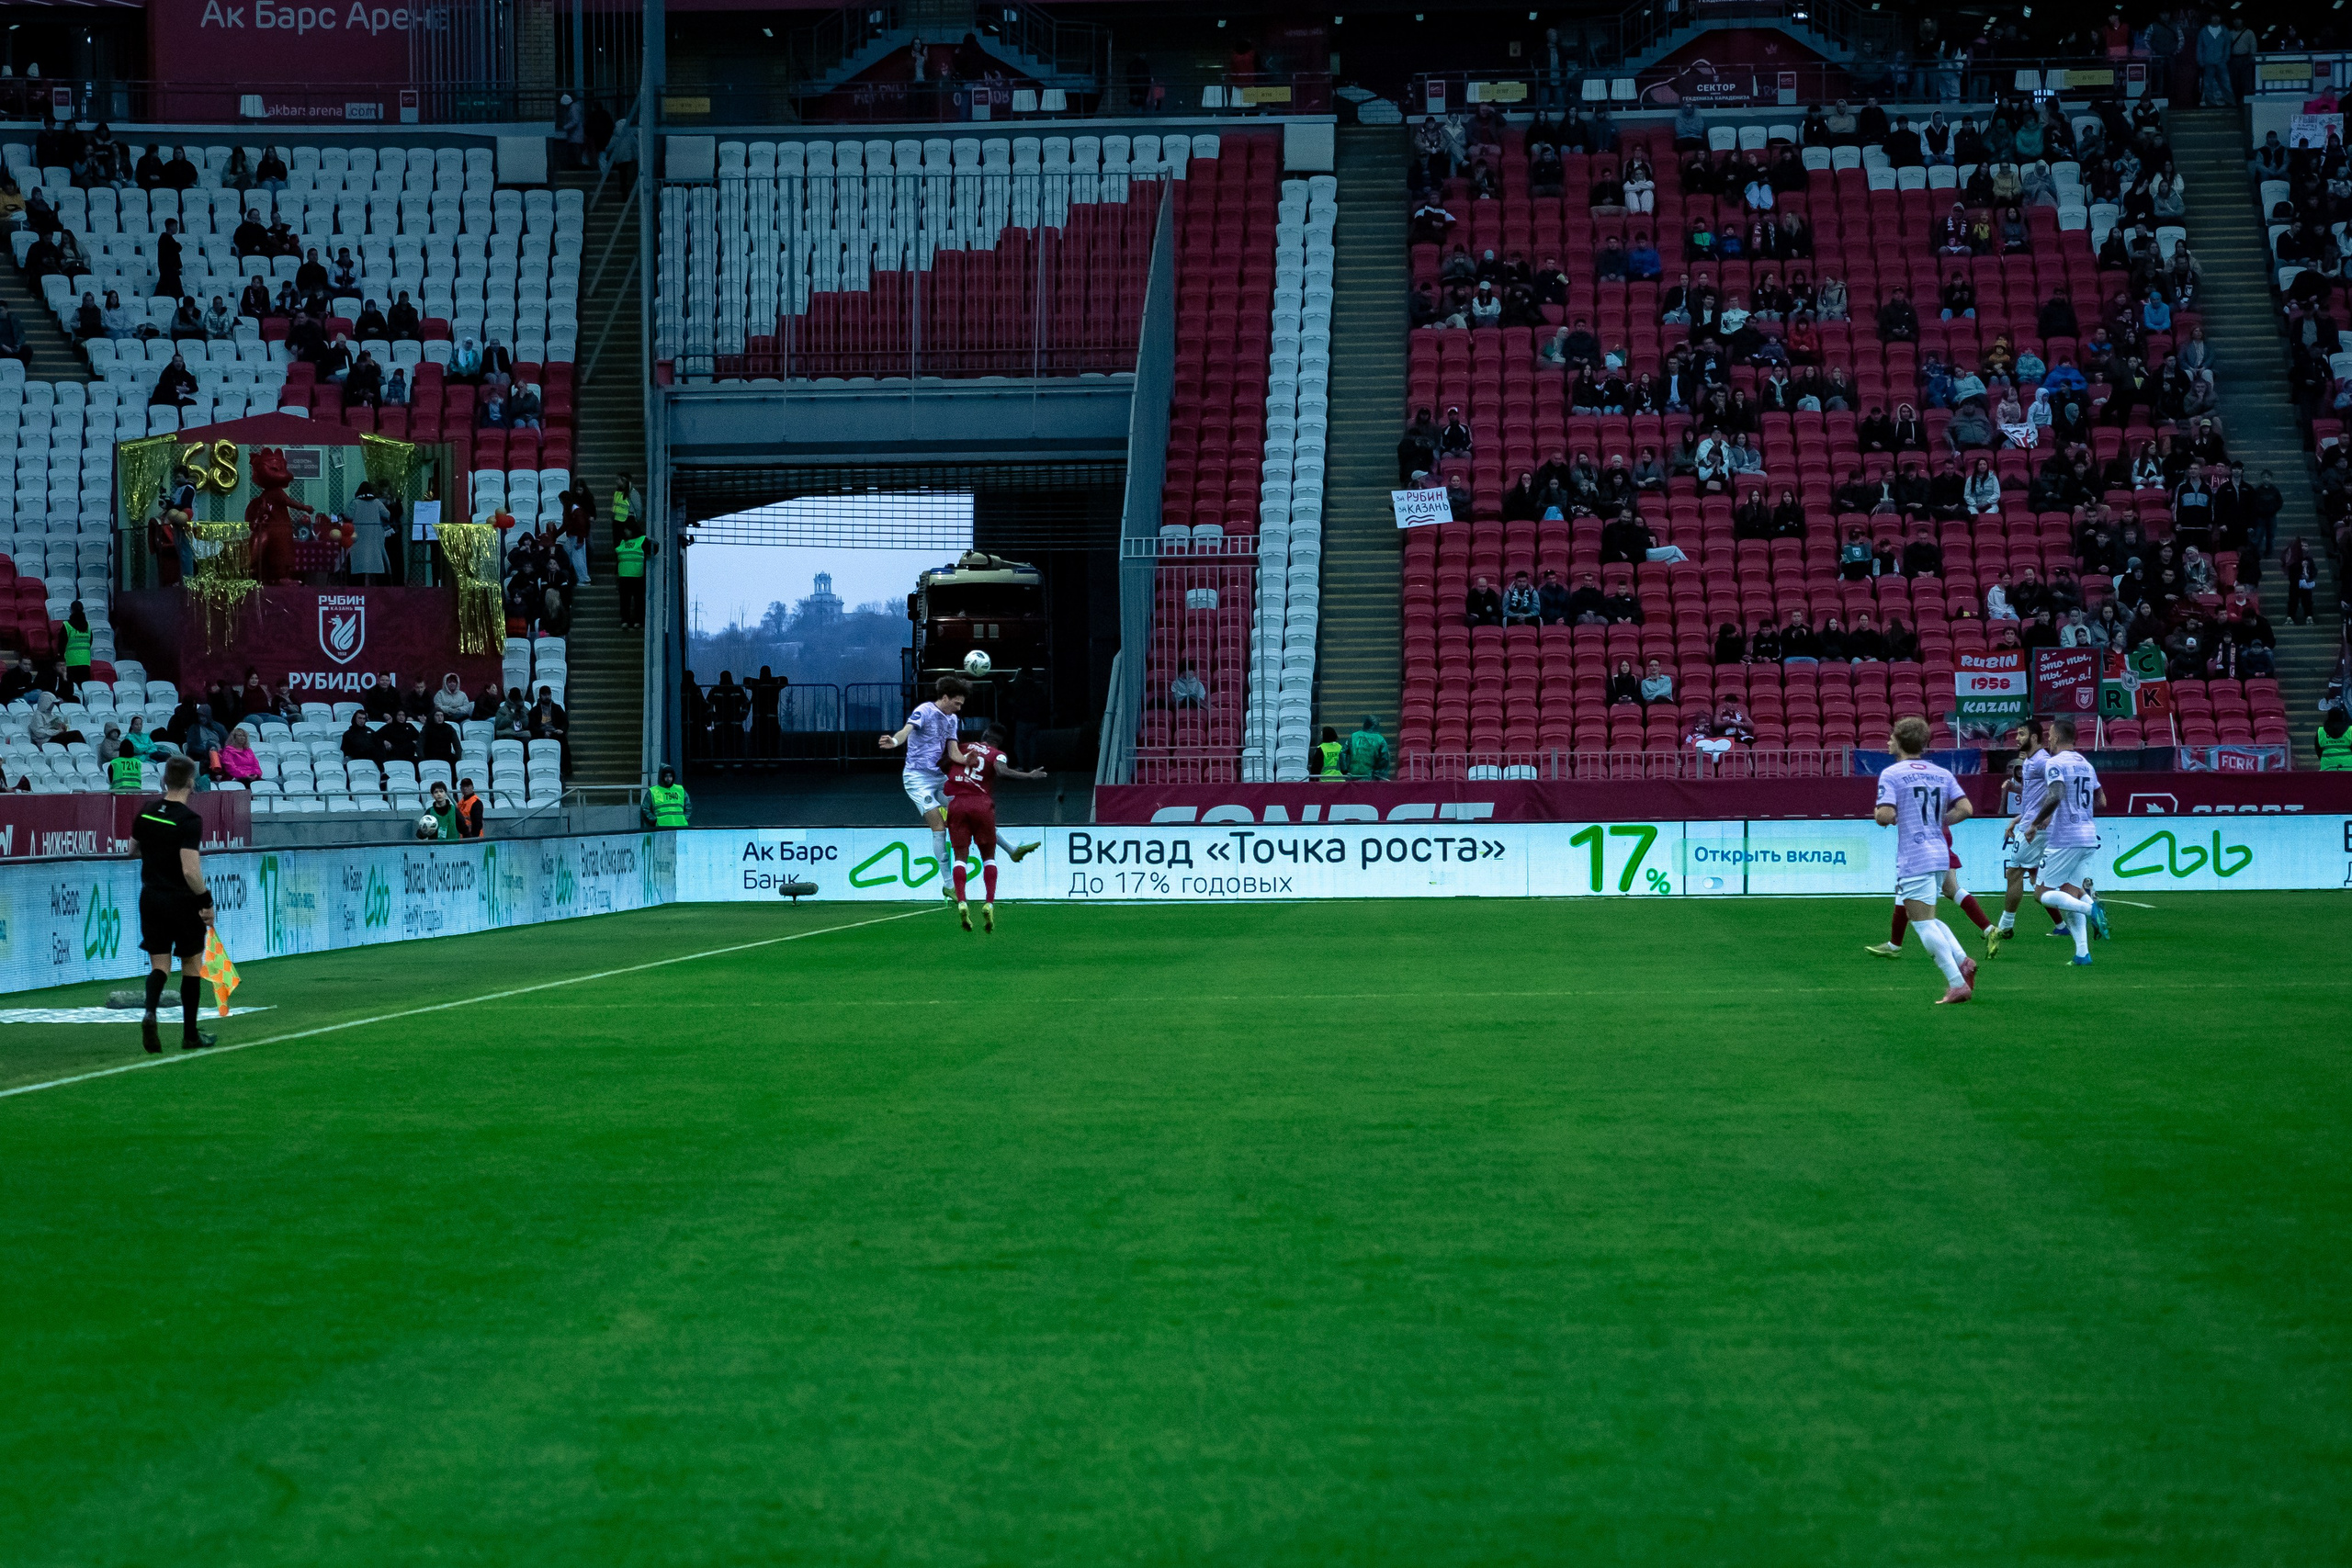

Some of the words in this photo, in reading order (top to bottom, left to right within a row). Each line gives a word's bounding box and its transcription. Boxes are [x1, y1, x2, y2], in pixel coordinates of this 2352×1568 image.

[200, 0, 244, 28] Ак
[255, 0, 336, 35] Барс
[1697, 84, 1736, 92] СЕКТОР
[1407, 491, 1443, 502] РУБИН
[1408, 502, 1449, 514] КАЗАНЬ
[318, 595, 366, 605] РУБИН
[1960, 654, 2018, 669] RUBIN
[1971, 677, 2011, 689] 1958
[1962, 700, 2021, 715] KAZAN
[121, 761, 140, 772] 7214
[2221, 754, 2256, 771] FCRK
[2074, 775, 2091, 809] 15
[1913, 785, 1941, 826] 71
[742, 841, 774, 861] Ак
[780, 841, 838, 864] Барс
[1069, 832, 1193, 869] Вклад
[1206, 831, 1346, 863] «Точка
[1361, 837, 1506, 870] роста»
[1693, 845, 1781, 866] Открыть
[1787, 850, 1847, 865] вклад
[1068, 872, 1104, 897] До
[1115, 872, 1170, 895] 17%
[1182, 877, 1294, 897] годовых
